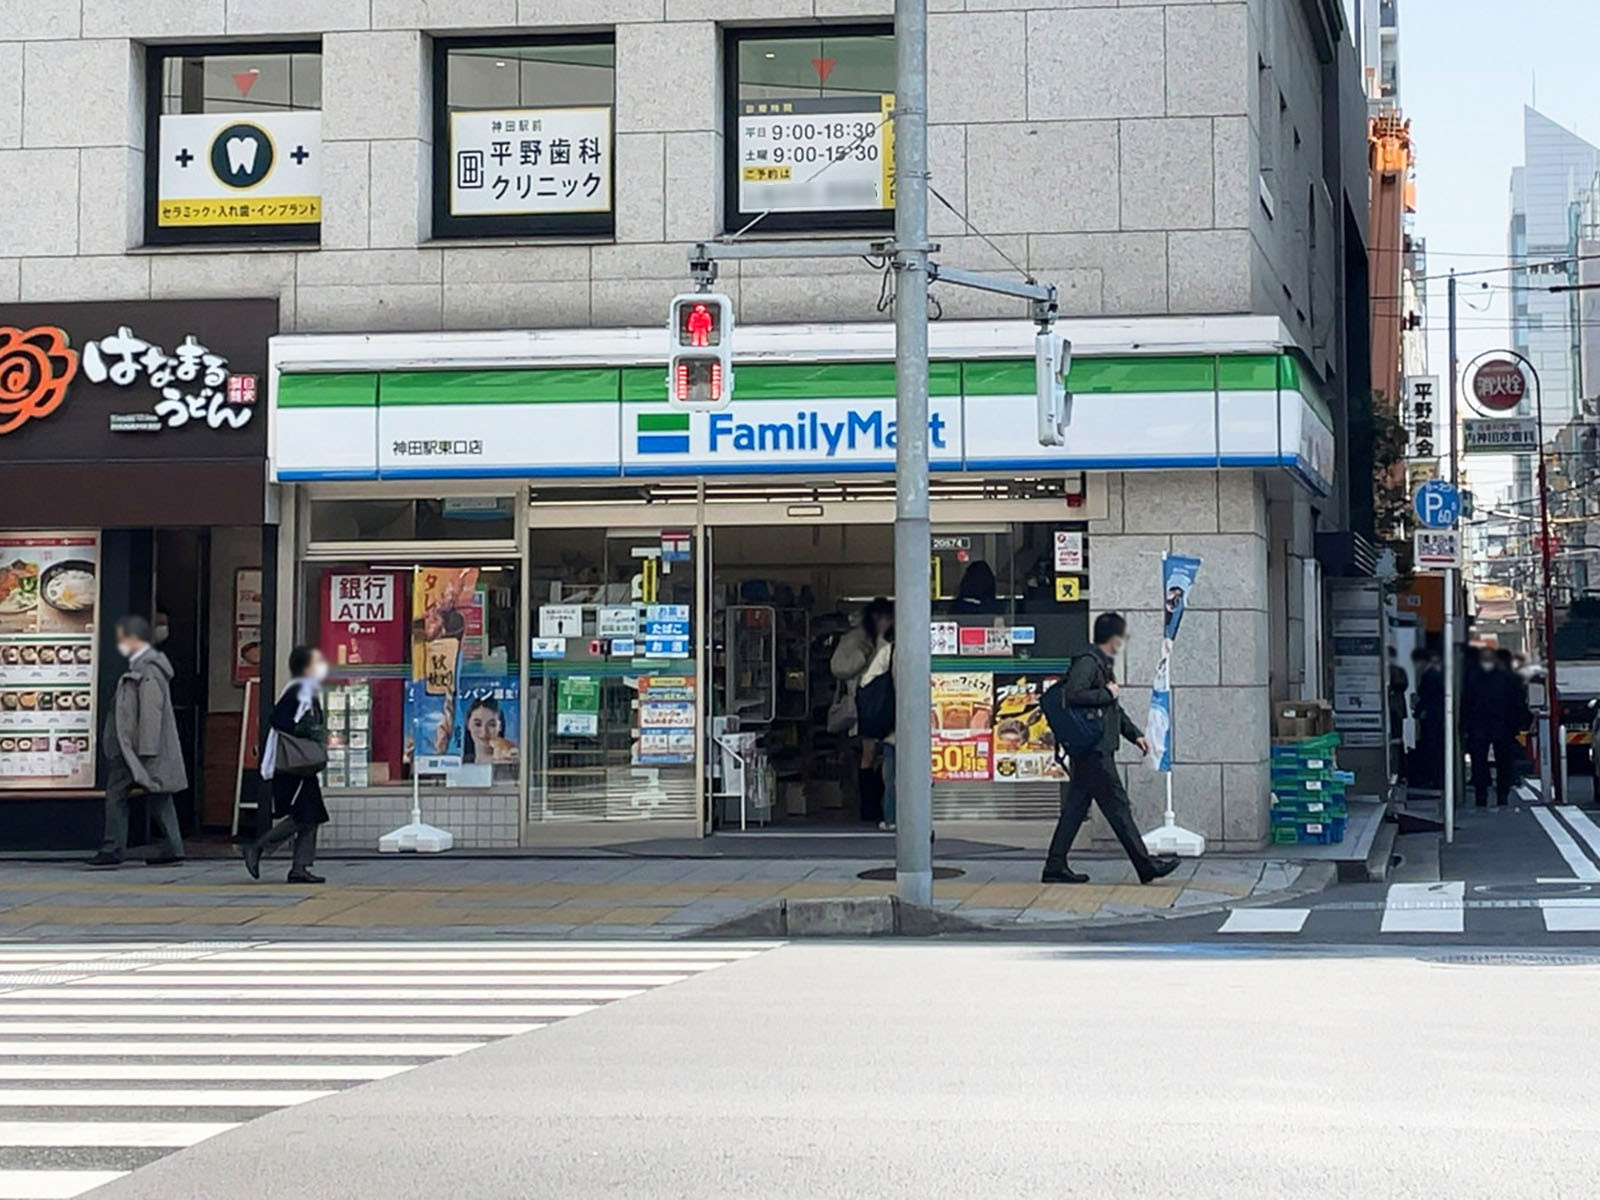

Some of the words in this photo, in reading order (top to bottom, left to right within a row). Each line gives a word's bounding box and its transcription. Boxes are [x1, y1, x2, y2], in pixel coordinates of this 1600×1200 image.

[492, 120, 542, 133] 神田駅前
[745, 127, 767, 138] 平日
[772, 122, 876, 141] 9:00-18:30
[491, 137, 601, 167] 平野歯科
[492, 172, 601, 200] クリニック
[83, 326, 230, 388] はなまる
[1477, 374, 1522, 397] 消火栓
[154, 387, 252, 429] うどん
[1414, 383, 1434, 457] 平野商会
[392, 440, 483, 456] 神田駅東口店
[1425, 493, 1444, 523] P
[338, 576, 386, 600] 銀行
[338, 603, 385, 620] ATM
[652, 623, 683, 634] たばこ
